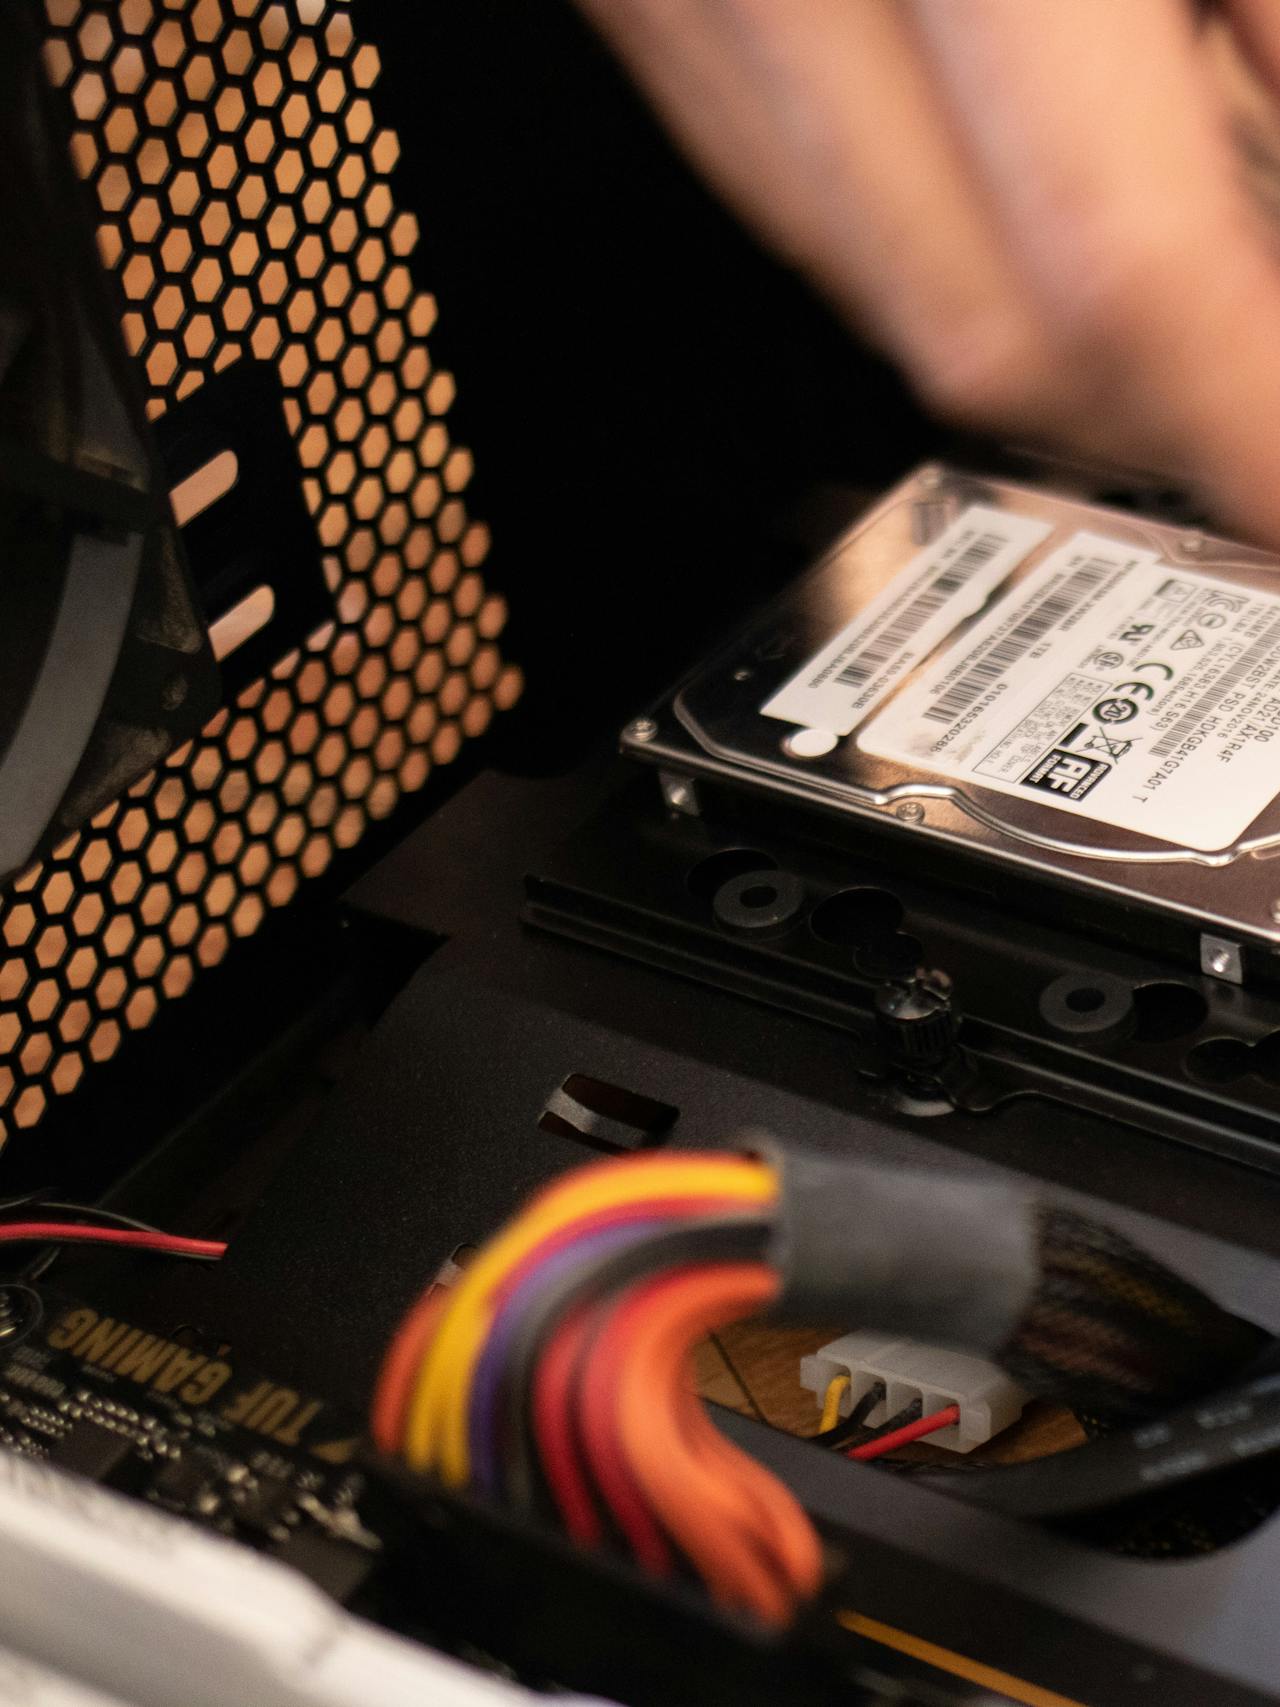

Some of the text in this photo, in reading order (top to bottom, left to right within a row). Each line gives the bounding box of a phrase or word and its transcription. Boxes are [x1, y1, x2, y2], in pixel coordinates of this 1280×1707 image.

[1215, 691, 1247, 713] PSD
[1025, 754, 1063, 784] FORMAT
[1046, 756, 1090, 794] AF
[47, 1307, 321, 1448] TUF GAMING
